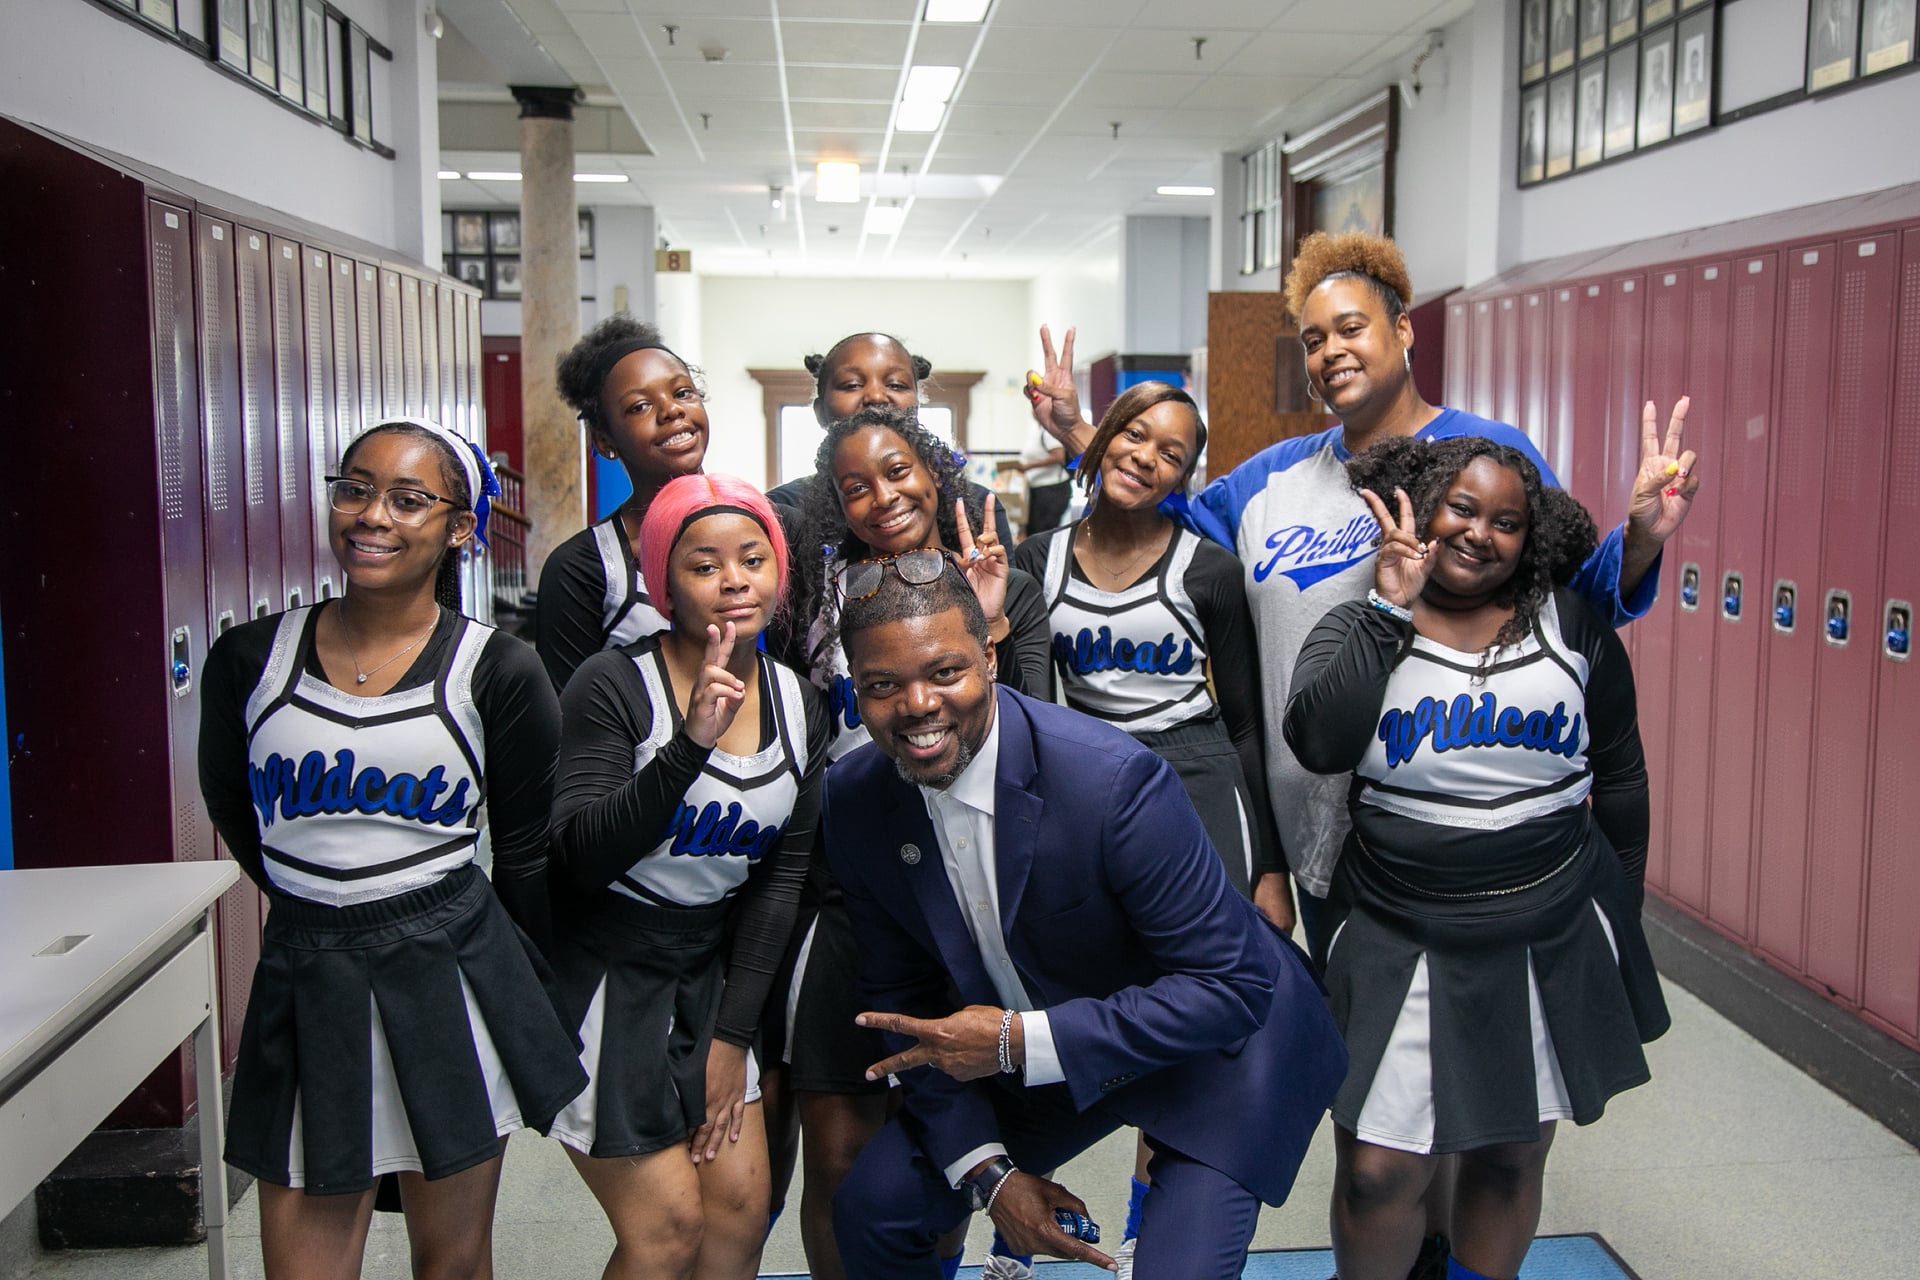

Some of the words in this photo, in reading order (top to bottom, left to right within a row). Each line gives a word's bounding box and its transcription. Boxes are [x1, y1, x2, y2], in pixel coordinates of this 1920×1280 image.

[668, 252, 681, 272] 8
[1253, 514, 1382, 583] Phillip
[1378, 692, 1582, 769] Wildcats
